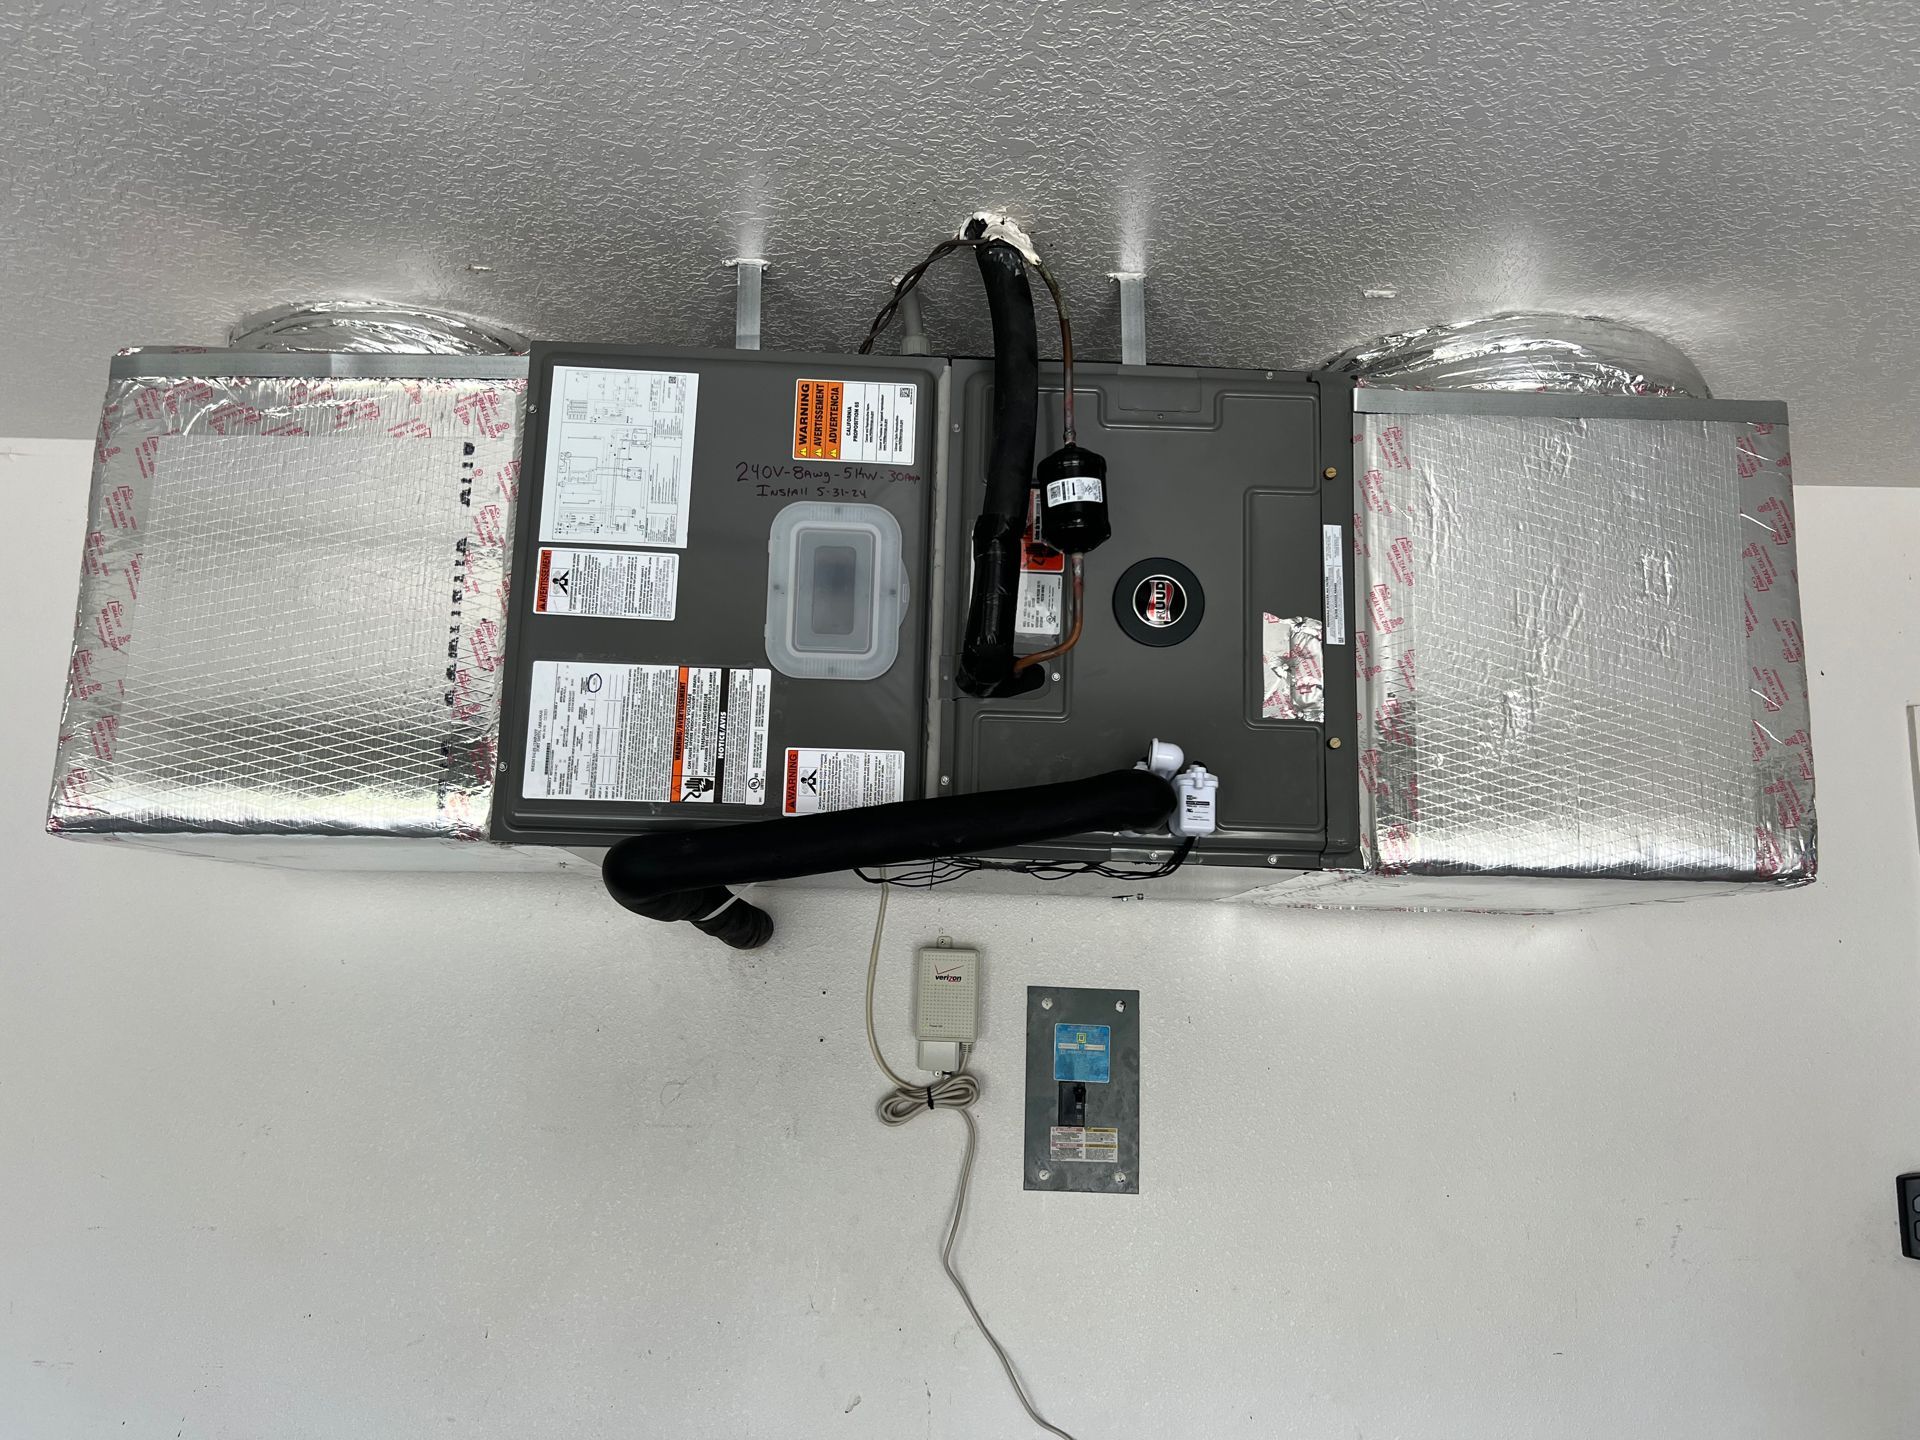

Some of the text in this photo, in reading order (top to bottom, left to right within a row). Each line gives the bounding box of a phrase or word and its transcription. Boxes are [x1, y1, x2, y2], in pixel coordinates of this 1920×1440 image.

[798, 383, 809, 445] WARNING
[813, 383, 824, 446] AVERTISSEMENT
[828, 386, 839, 443] ADVERTENCIA
[537, 551, 551, 602] AVERTISSEMENT
[1155, 582, 1166, 620] RUUD
[674, 681, 686, 760] WARNING/AVERTISSEMENT
[717, 711, 726, 758] NOTICE/AVIS
[786, 754, 797, 800] WARNING
[935, 972, 961, 982] verizon
